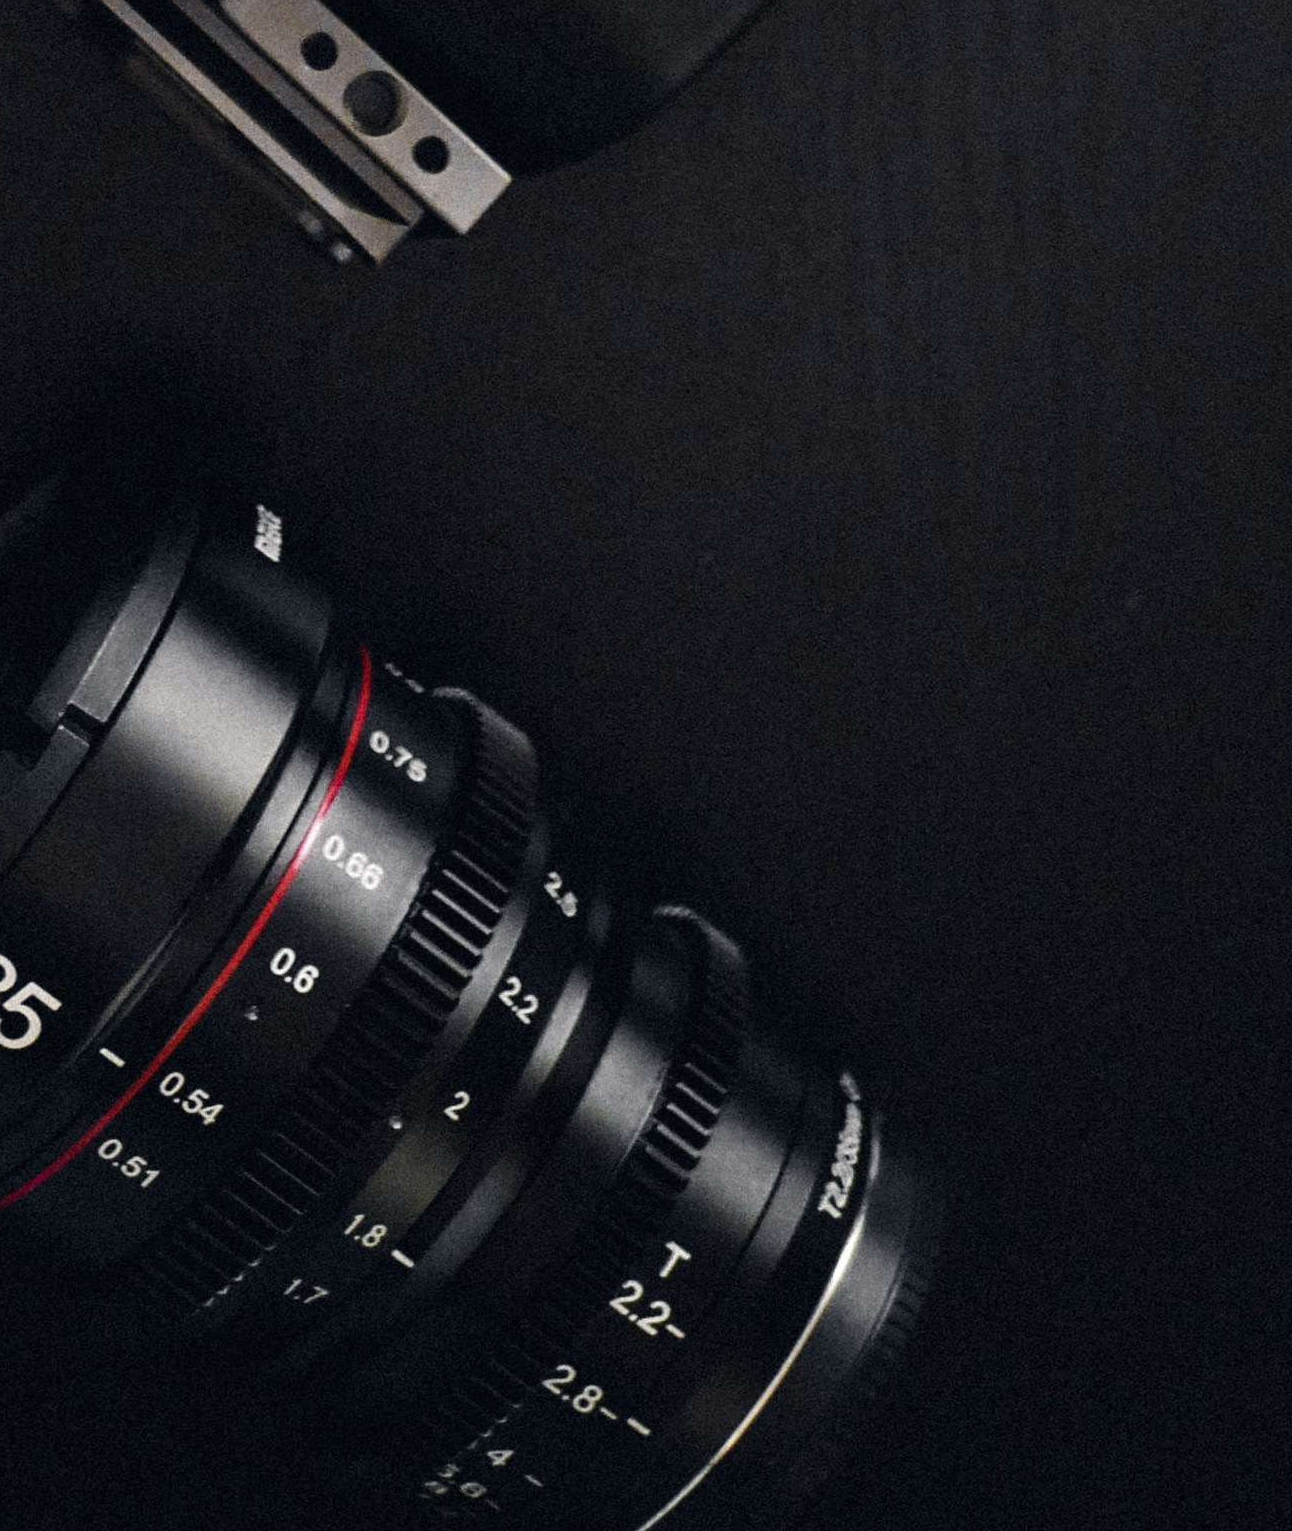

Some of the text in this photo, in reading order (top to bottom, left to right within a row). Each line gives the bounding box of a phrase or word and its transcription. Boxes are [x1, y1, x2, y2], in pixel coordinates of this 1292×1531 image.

[369, 730, 427, 783] 0.75
[322, 834, 384, 891] 0.66
[270, 947, 319, 994] 0.6
[498, 976, 540, 1025] 2.2
[159, 1071, 224, 1125] 0.54
[444, 1091, 470, 1121] 2
[97, 1138, 160, 1188] 0.51
[344, 1214, 387, 1248] 1.8
[659, 1241, 691, 1278] T
[284, 1278, 329, 1304] 1.7
[609, 1280, 670, 1336] 2.2
[542, 1364, 603, 1413] 2.8
[487, 1449, 514, 1466] 4
